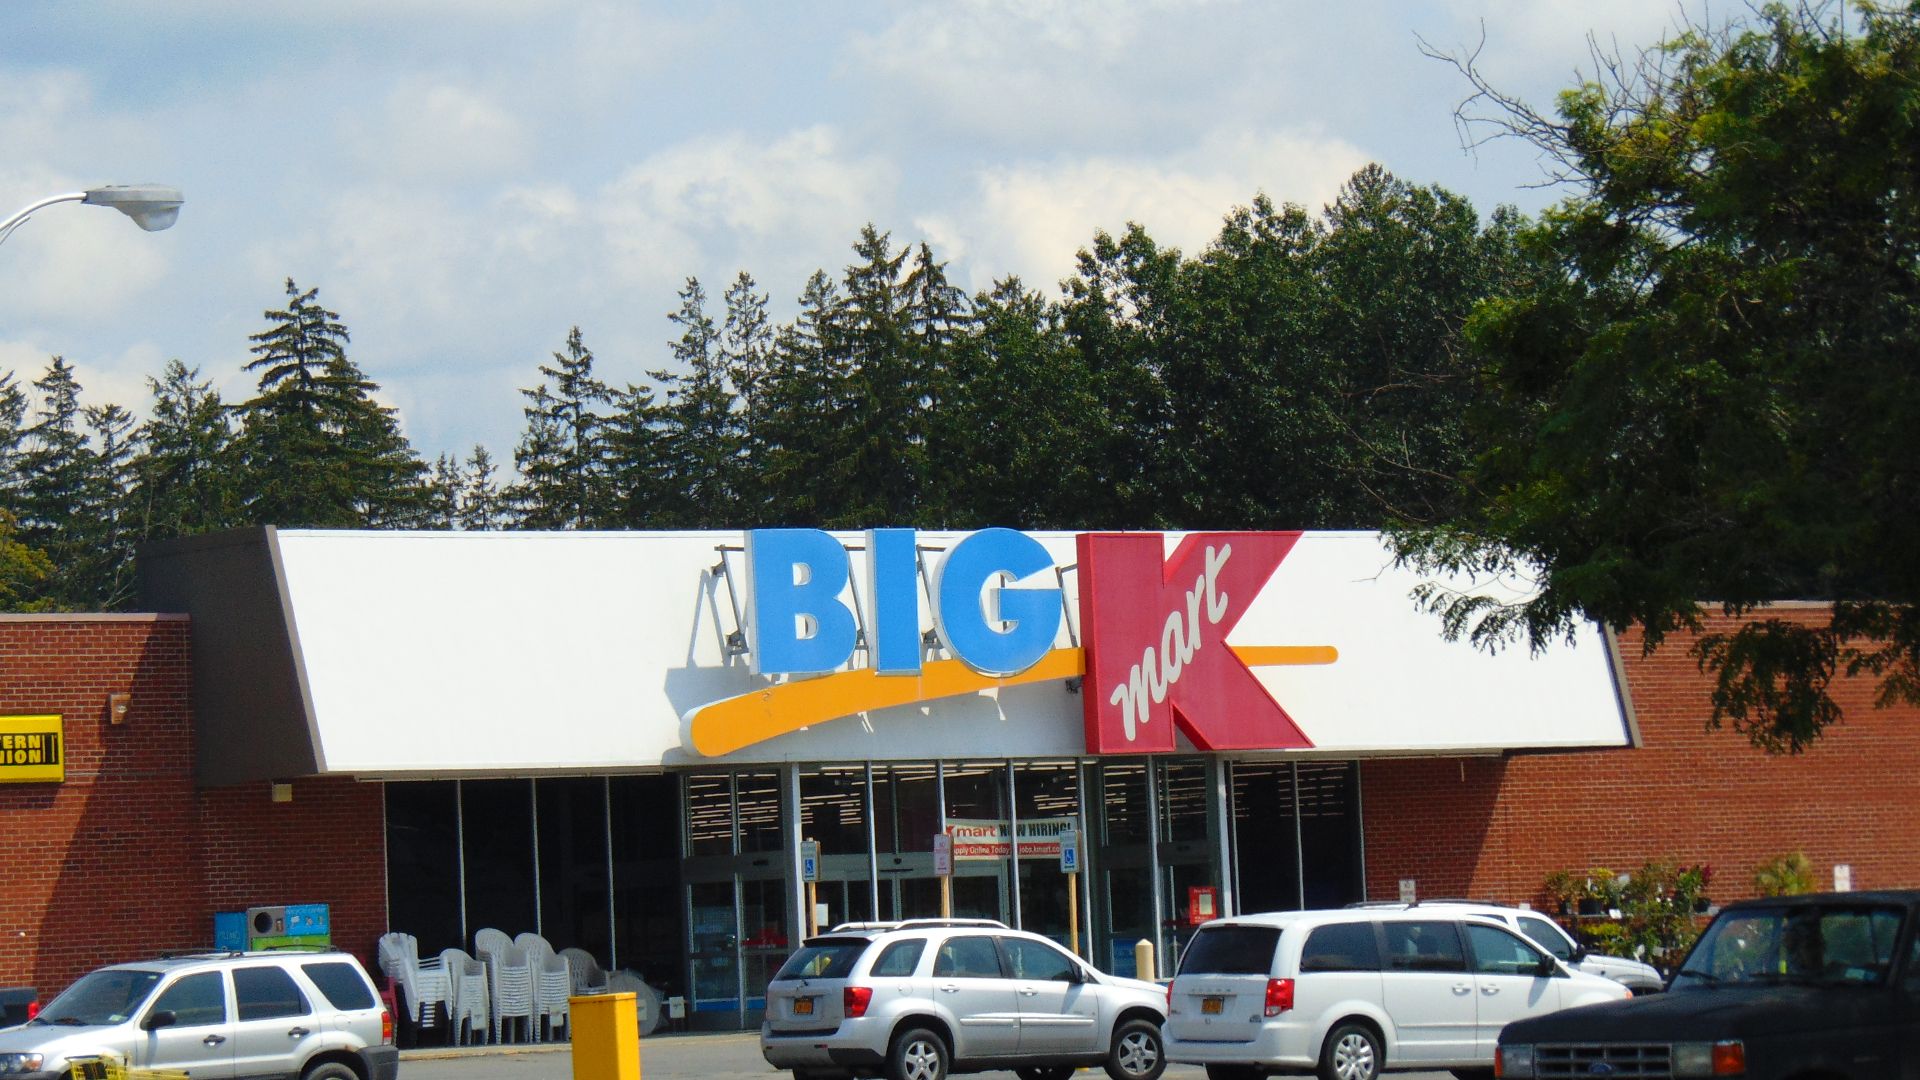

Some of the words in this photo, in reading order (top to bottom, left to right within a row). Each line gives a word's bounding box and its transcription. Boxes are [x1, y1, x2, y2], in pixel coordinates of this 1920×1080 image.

[745, 527, 1063, 677] BIG
[1110, 543, 1232, 741] mart
[0, 734, 41, 749] ERN
[999, 823, 1026, 837] NW
[953, 846, 968, 855] pply
[970, 846, 990, 855] Online
[1019, 845, 1061, 855] jobs.kmart.co
